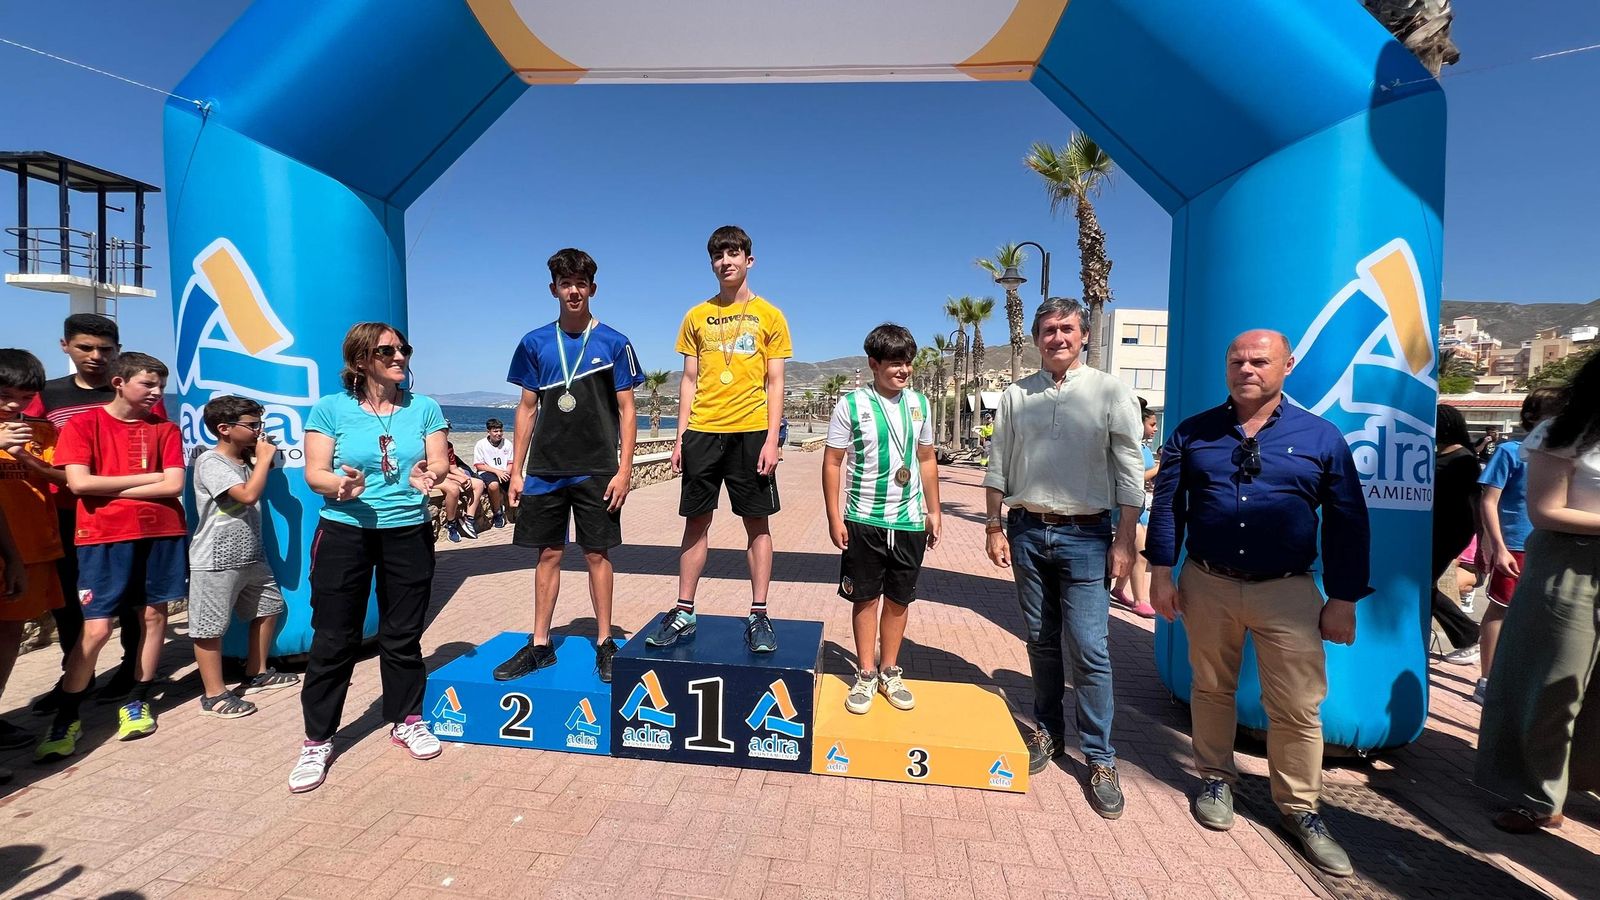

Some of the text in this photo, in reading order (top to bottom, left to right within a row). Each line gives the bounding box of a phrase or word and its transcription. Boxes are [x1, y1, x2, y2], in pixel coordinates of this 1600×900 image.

[706, 313, 760, 325] Converse
[492, 457, 502, 466] 10
[1349, 425, 1432, 485] dra
[500, 693, 533, 741] 2
[686, 678, 734, 752] 1
[434, 720, 463, 732] adra
[623, 725, 671, 744] adra
[567, 732, 597, 745] adra
[749, 734, 799, 754] adra
[906, 748, 929, 778] 3
